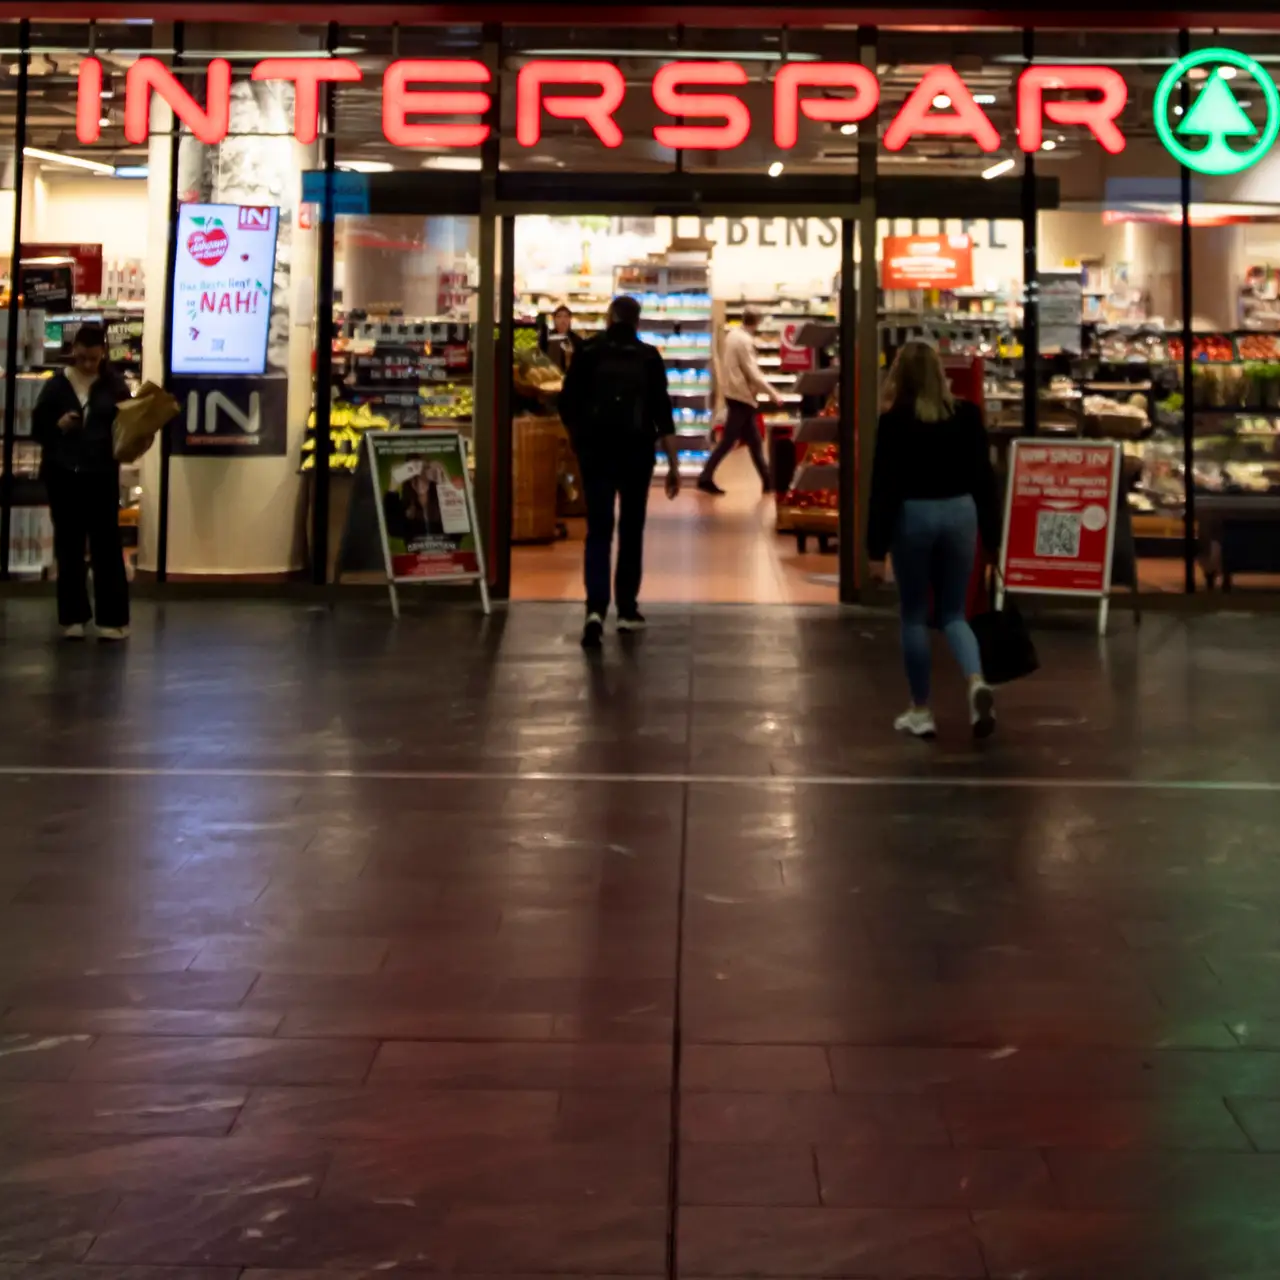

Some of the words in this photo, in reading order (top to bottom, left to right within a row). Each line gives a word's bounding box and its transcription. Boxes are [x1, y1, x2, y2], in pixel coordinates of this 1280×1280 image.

[74, 56, 1130, 156] INTERSPAR
[240, 208, 267, 224] IN
[200, 291, 259, 315] NAH!
[186, 389, 262, 434] IN
